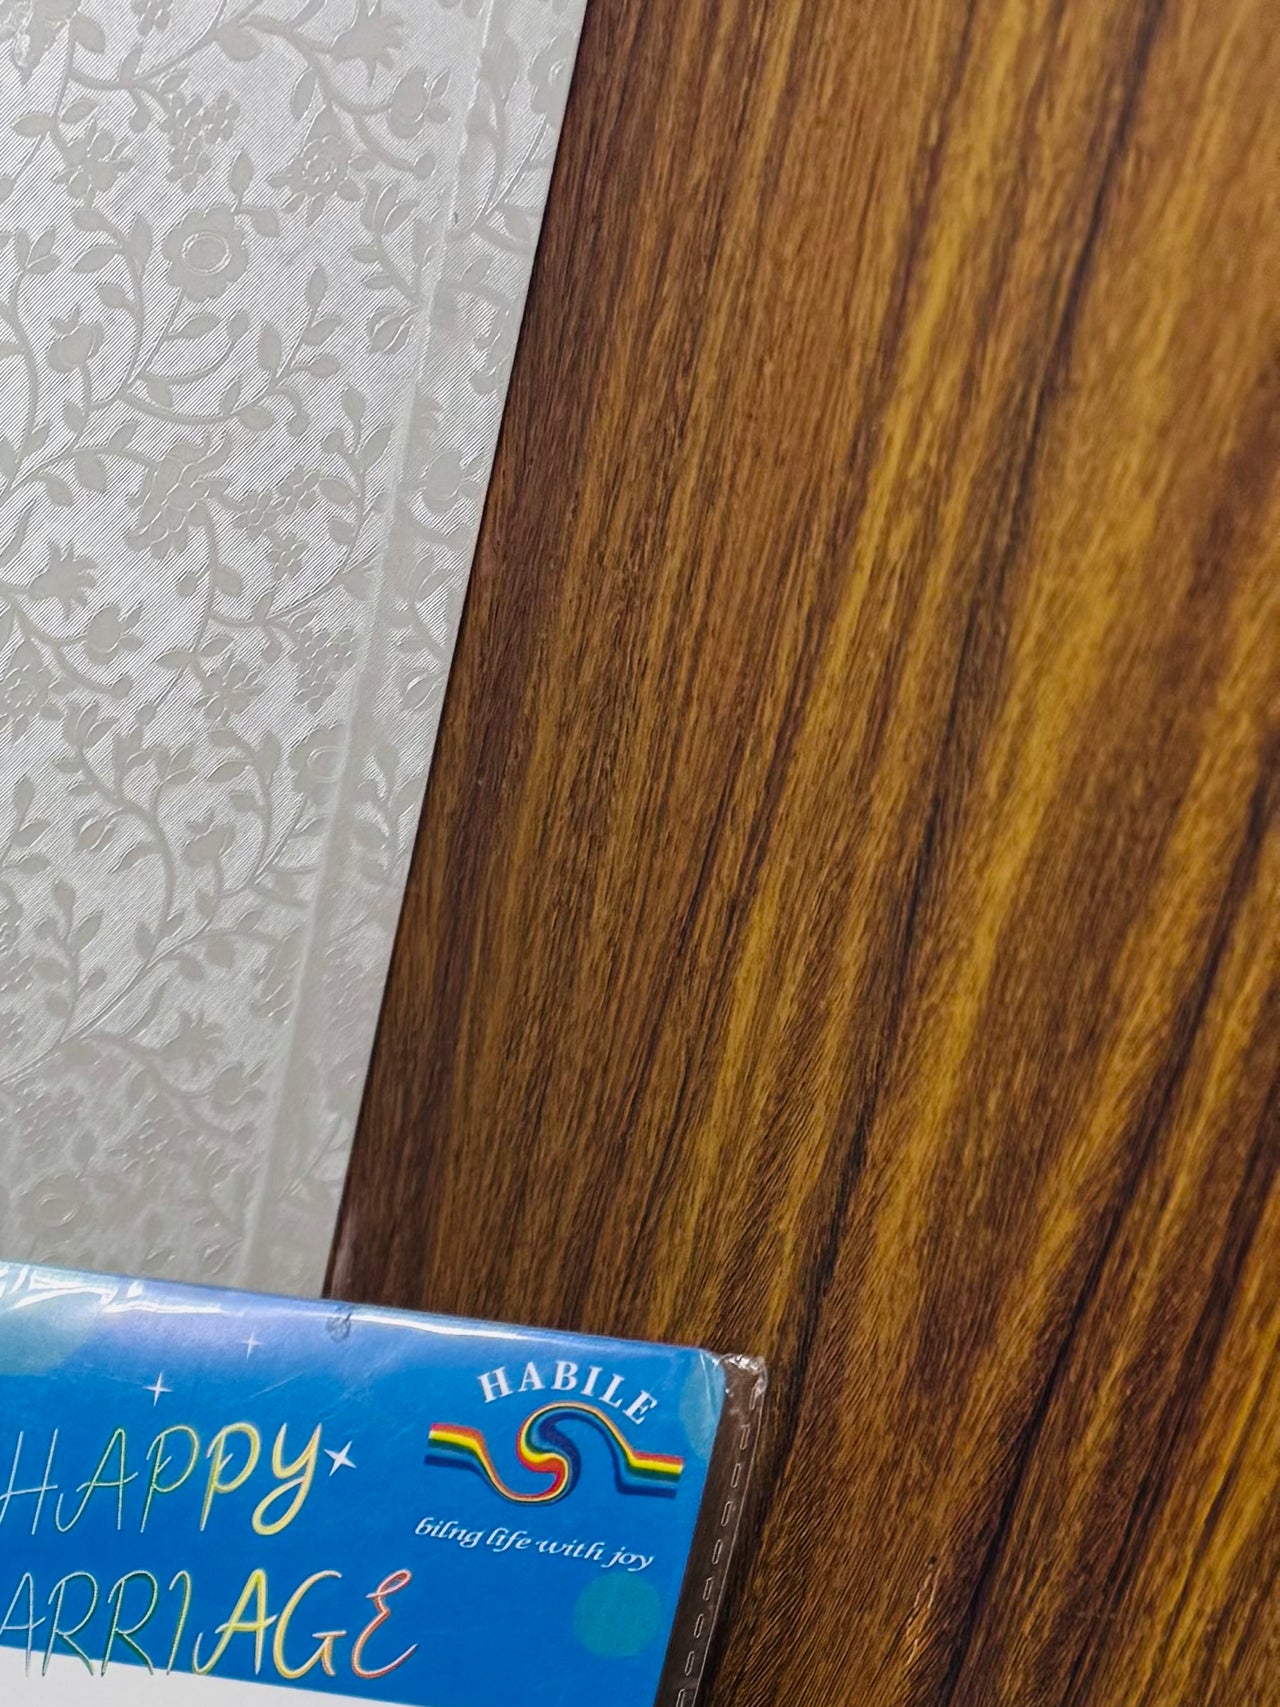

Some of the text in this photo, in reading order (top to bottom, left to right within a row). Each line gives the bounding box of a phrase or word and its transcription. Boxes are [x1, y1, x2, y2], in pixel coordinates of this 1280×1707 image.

[477, 1360, 658, 1425] HABILE
[486, 1527, 532, 1553] life
[535, 1539, 603, 1561] with
[601, 1546, 654, 1572] joy
